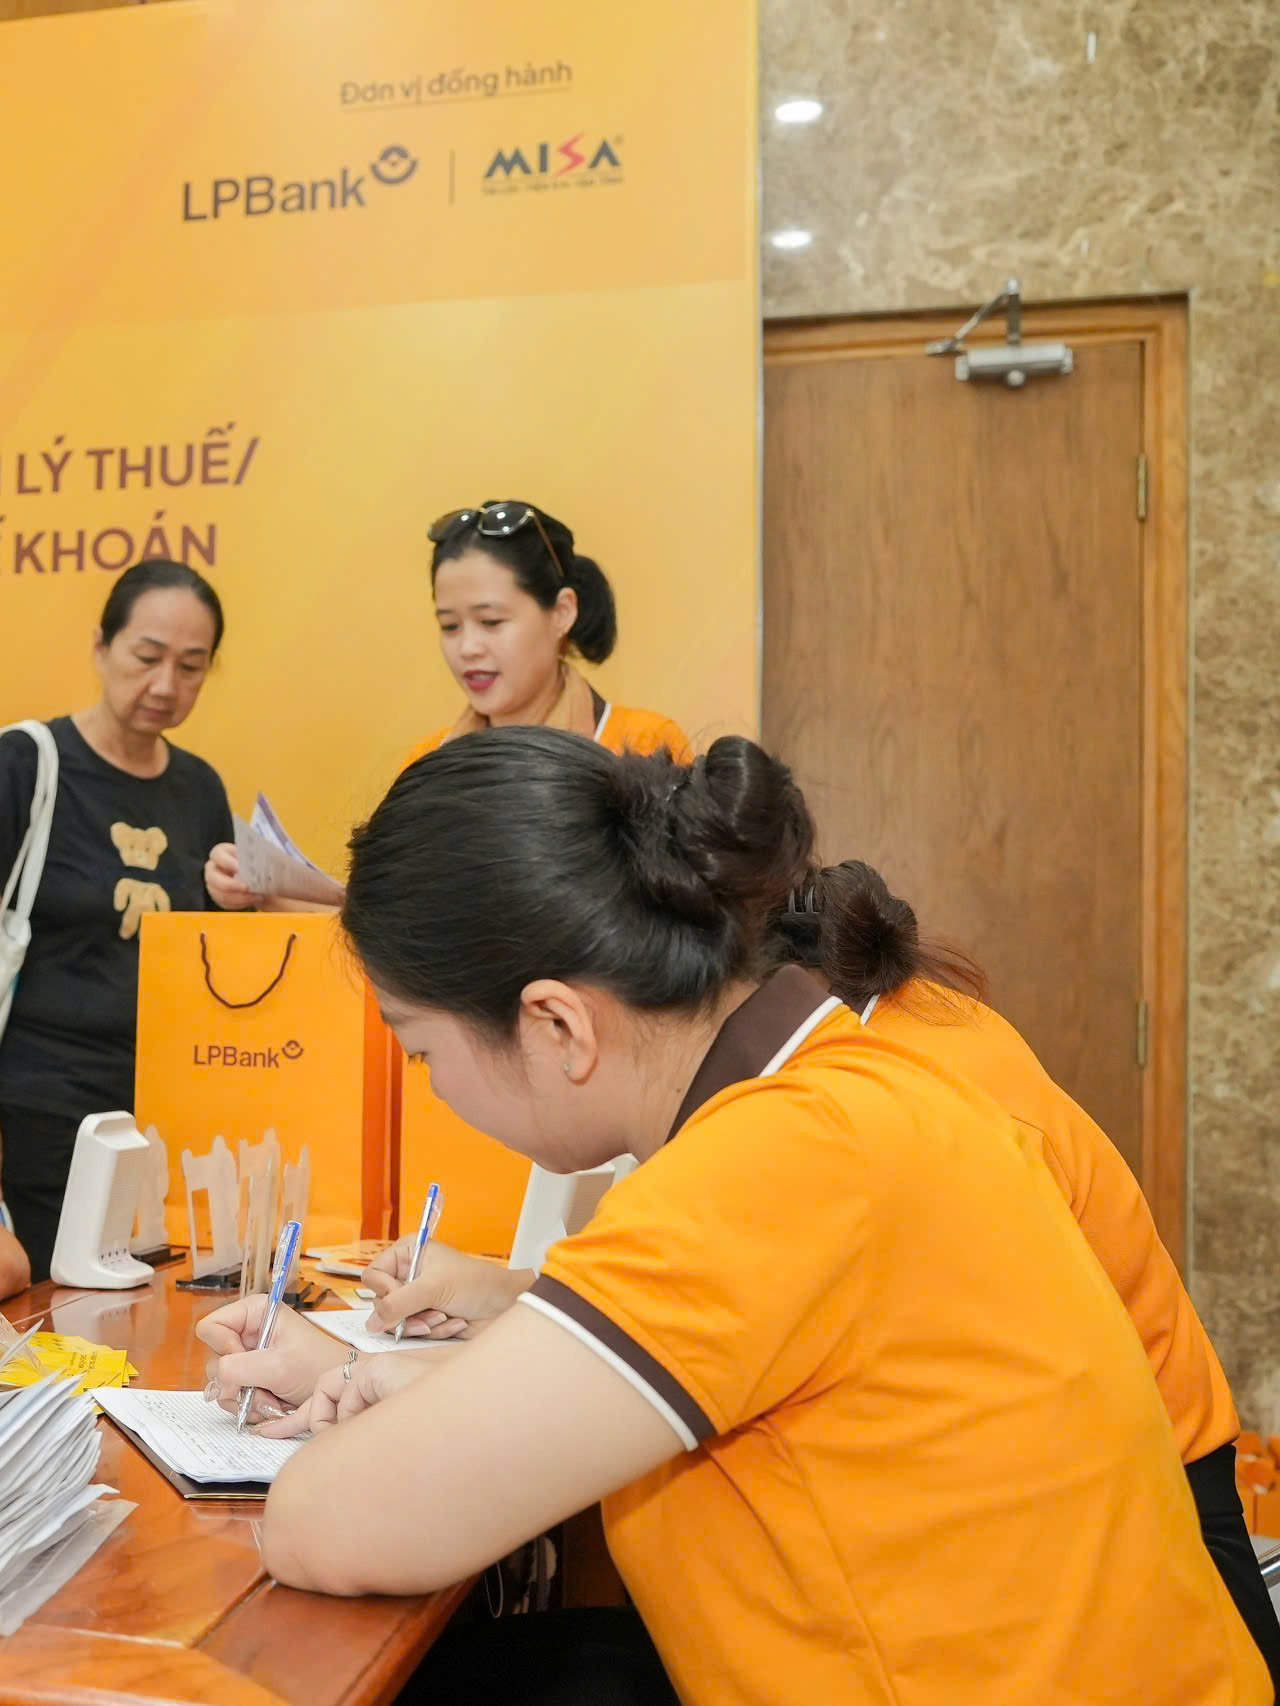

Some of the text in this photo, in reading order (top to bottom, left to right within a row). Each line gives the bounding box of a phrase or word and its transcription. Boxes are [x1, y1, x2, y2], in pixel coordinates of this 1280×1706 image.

[505, 60, 573, 88] hành
[483, 132, 622, 179] MISA
[183, 168, 365, 222] LPBank
[17, 435, 72, 495] LÝ
[86, 422, 259, 490] THUẾ/
[14, 510, 216, 572] KHOÁN
[193, 1044, 280, 1069] LPBank
